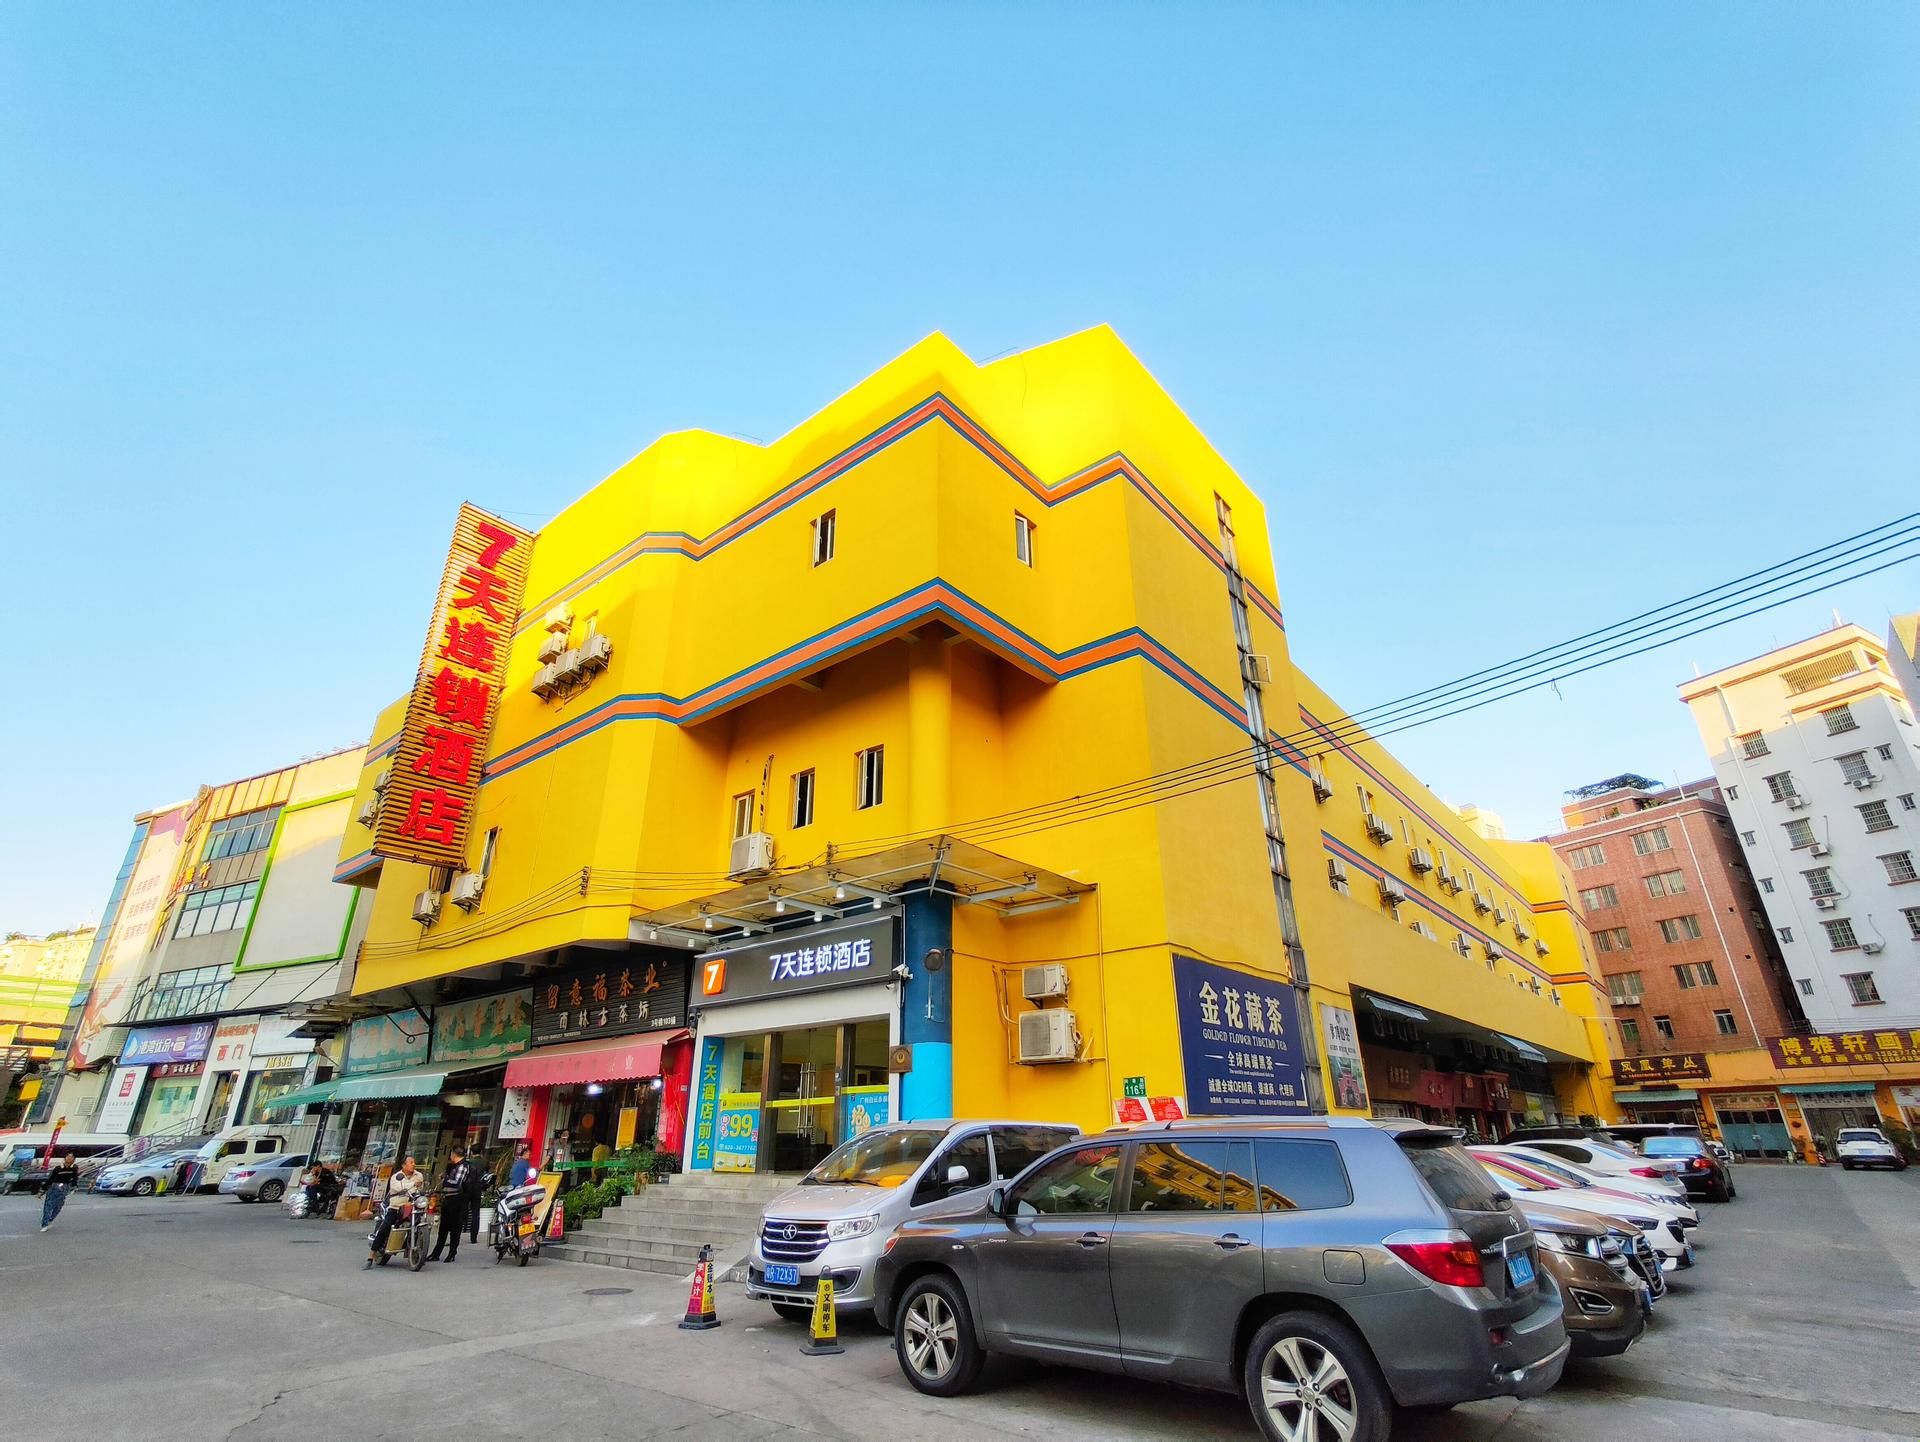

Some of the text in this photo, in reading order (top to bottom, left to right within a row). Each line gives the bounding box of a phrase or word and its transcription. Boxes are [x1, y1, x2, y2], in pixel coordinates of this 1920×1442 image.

[706, 963, 719, 991] 7
[769, 938, 873, 981] 7天连锁酒店
[1199, 981, 1284, 1036] 金花藏茶
[696, 1045, 718, 1161] 7天酒店前台
[729, 1113, 753, 1138] 99
[822, 1293, 831, 1333] 文明停车
